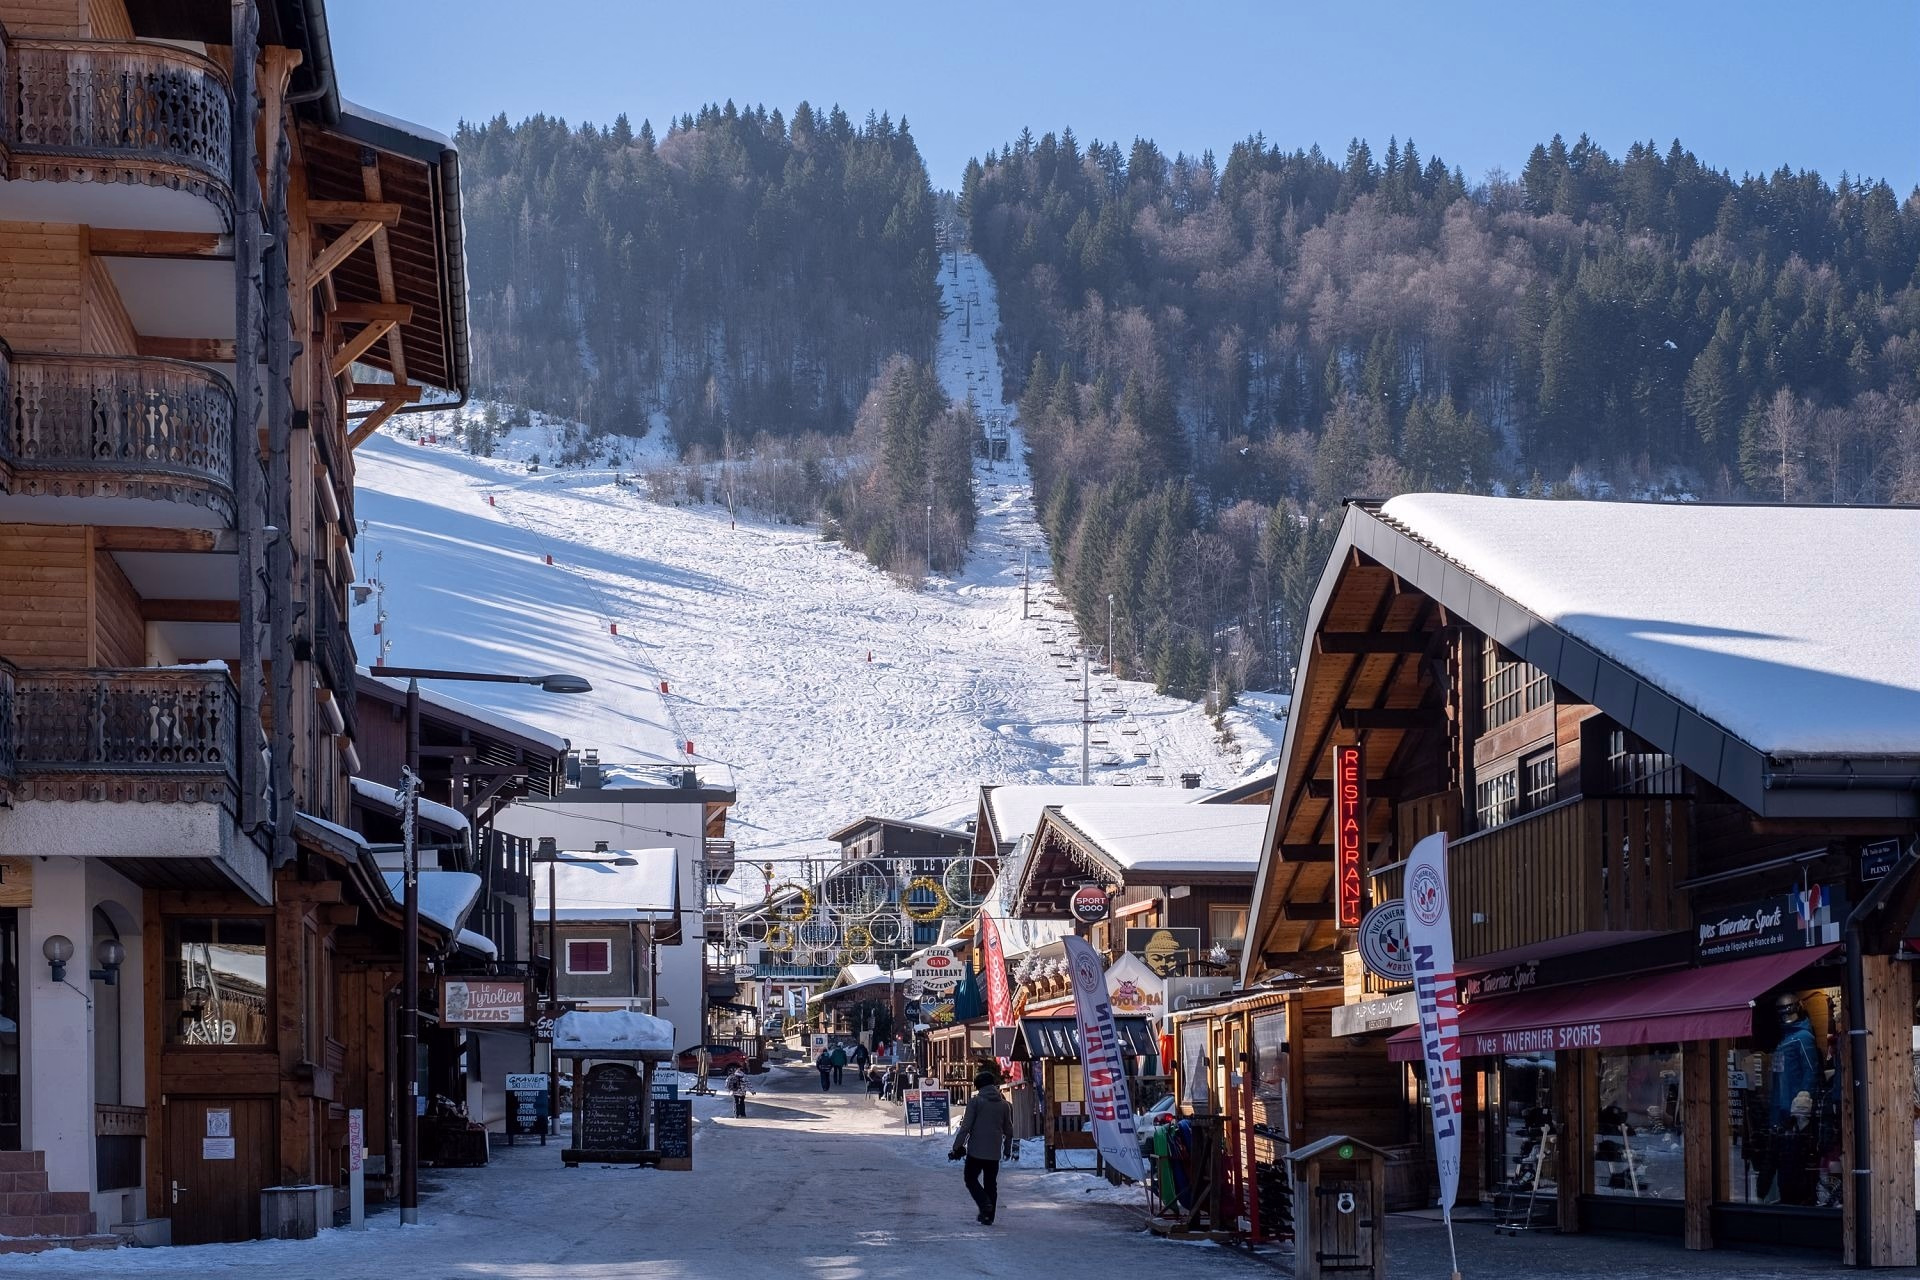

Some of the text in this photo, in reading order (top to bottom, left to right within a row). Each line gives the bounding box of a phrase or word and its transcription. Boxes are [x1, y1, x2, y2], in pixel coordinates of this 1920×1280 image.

[1344, 750, 1360, 914] RESTAURANT
[923, 860, 935, 871] LE
[1079, 904, 1103, 912] 2000
[1369, 909, 1405, 935] YVES TAVERN
[1699, 906, 1782, 947] Yves Tavernier Sports
[1707, 945, 1725, 955] membre
[1725, 944, 1731, 952] de
[1748, 940, 1754, 948] de
[1754, 937, 1770, 946] France
[1770, 935, 1776, 943] de
[1776, 933, 1784, 943] ski
[916, 969, 962, 977] RESTAURANT
[1386, 962, 1413, 972] MORZI
[481, 983, 490, 992] Le
[923, 980, 955, 989] PIZZERIA
[1467, 965, 1536, 999] Yves Tavernier Sports
[1185, 983, 1215, 996] THE
[470, 988, 523, 1007] Tyrolien
[463, 1010, 510, 1020] PIZZAS
[537, 1030, 554, 1038] SKI
[1477, 1024, 1601, 1053] Yves TAVERNIER SPORTS
[1413, 944, 1455, 1139] LOCATION
